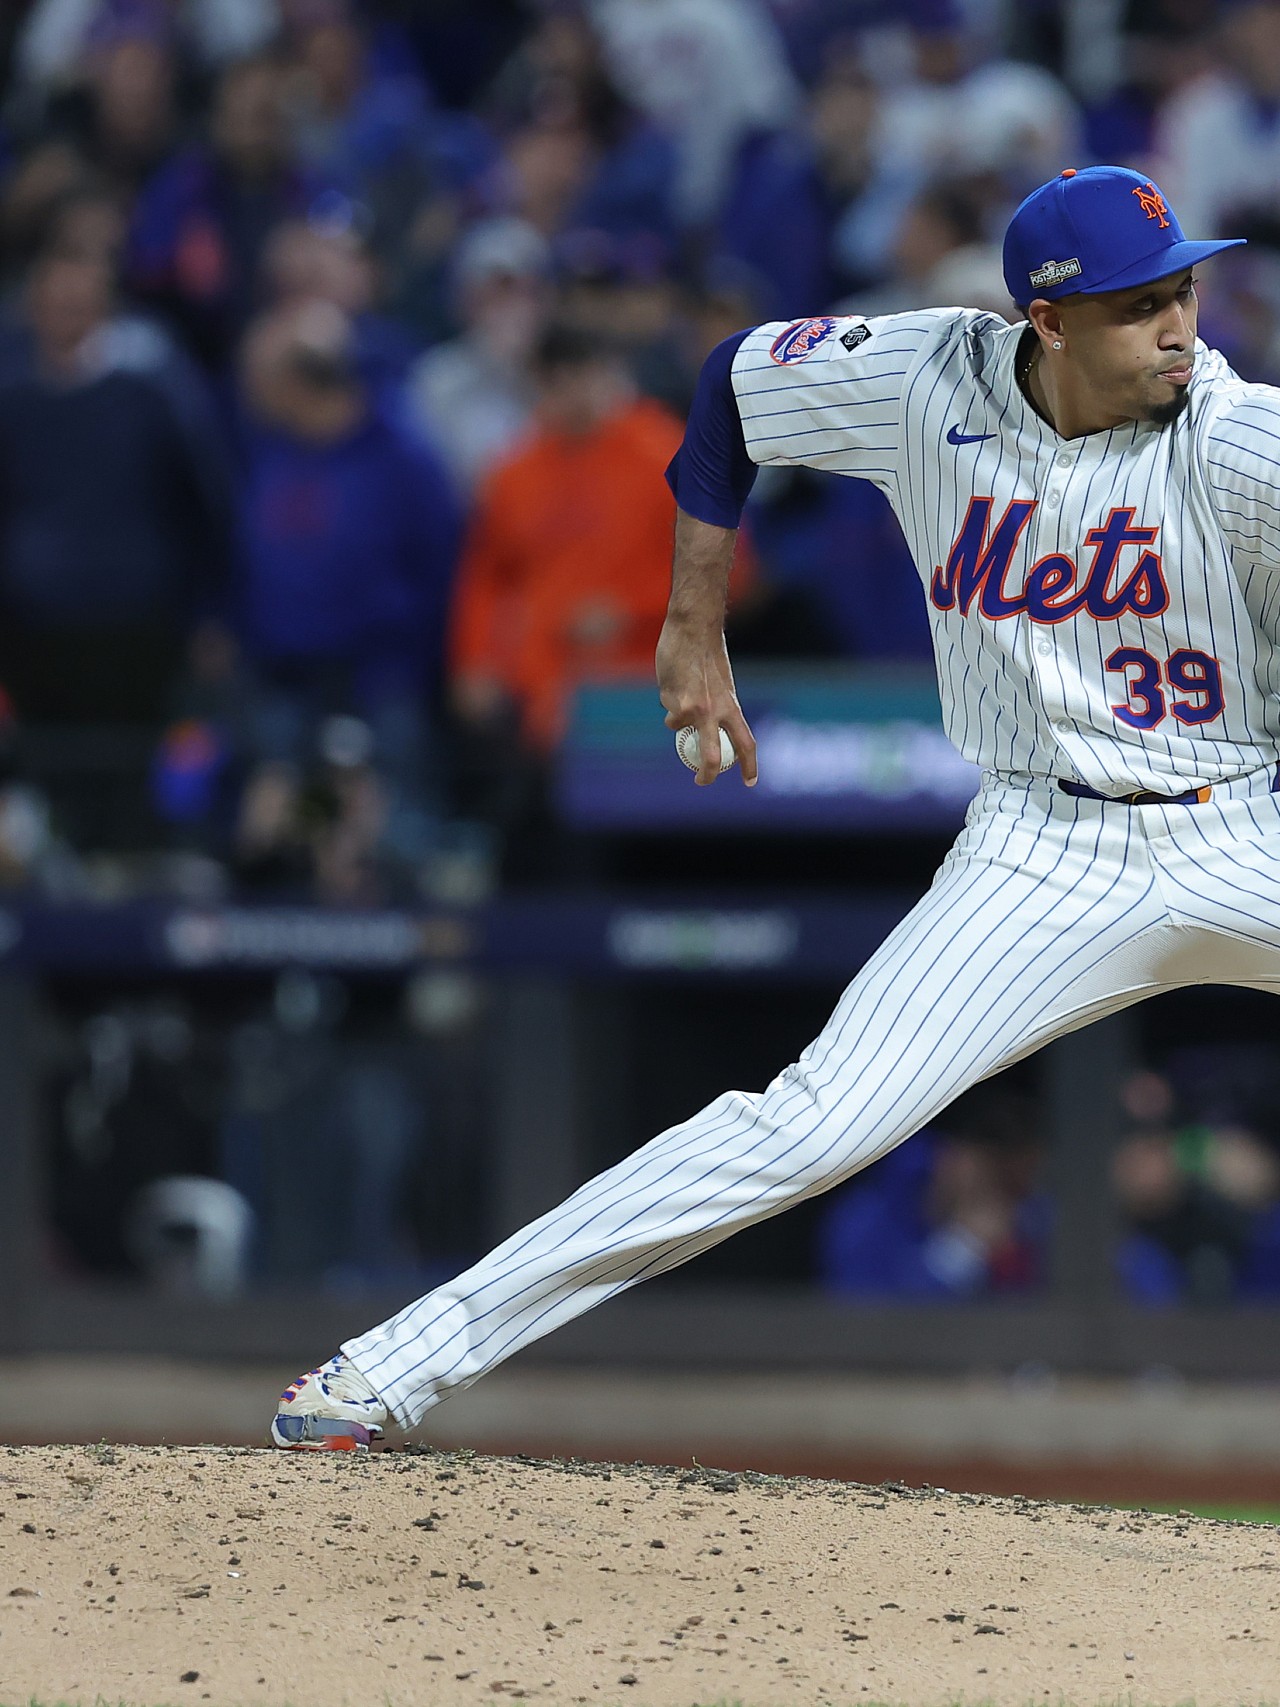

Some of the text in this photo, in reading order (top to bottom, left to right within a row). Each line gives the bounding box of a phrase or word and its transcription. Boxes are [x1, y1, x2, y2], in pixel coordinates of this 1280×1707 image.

[1131, 183, 1170, 229] NY
[1030, 262, 1079, 285] POSTSEASON
[786, 322, 828, 356] Mets
[931, 495, 1170, 625] Mets
[1105, 646, 1226, 731] 39
